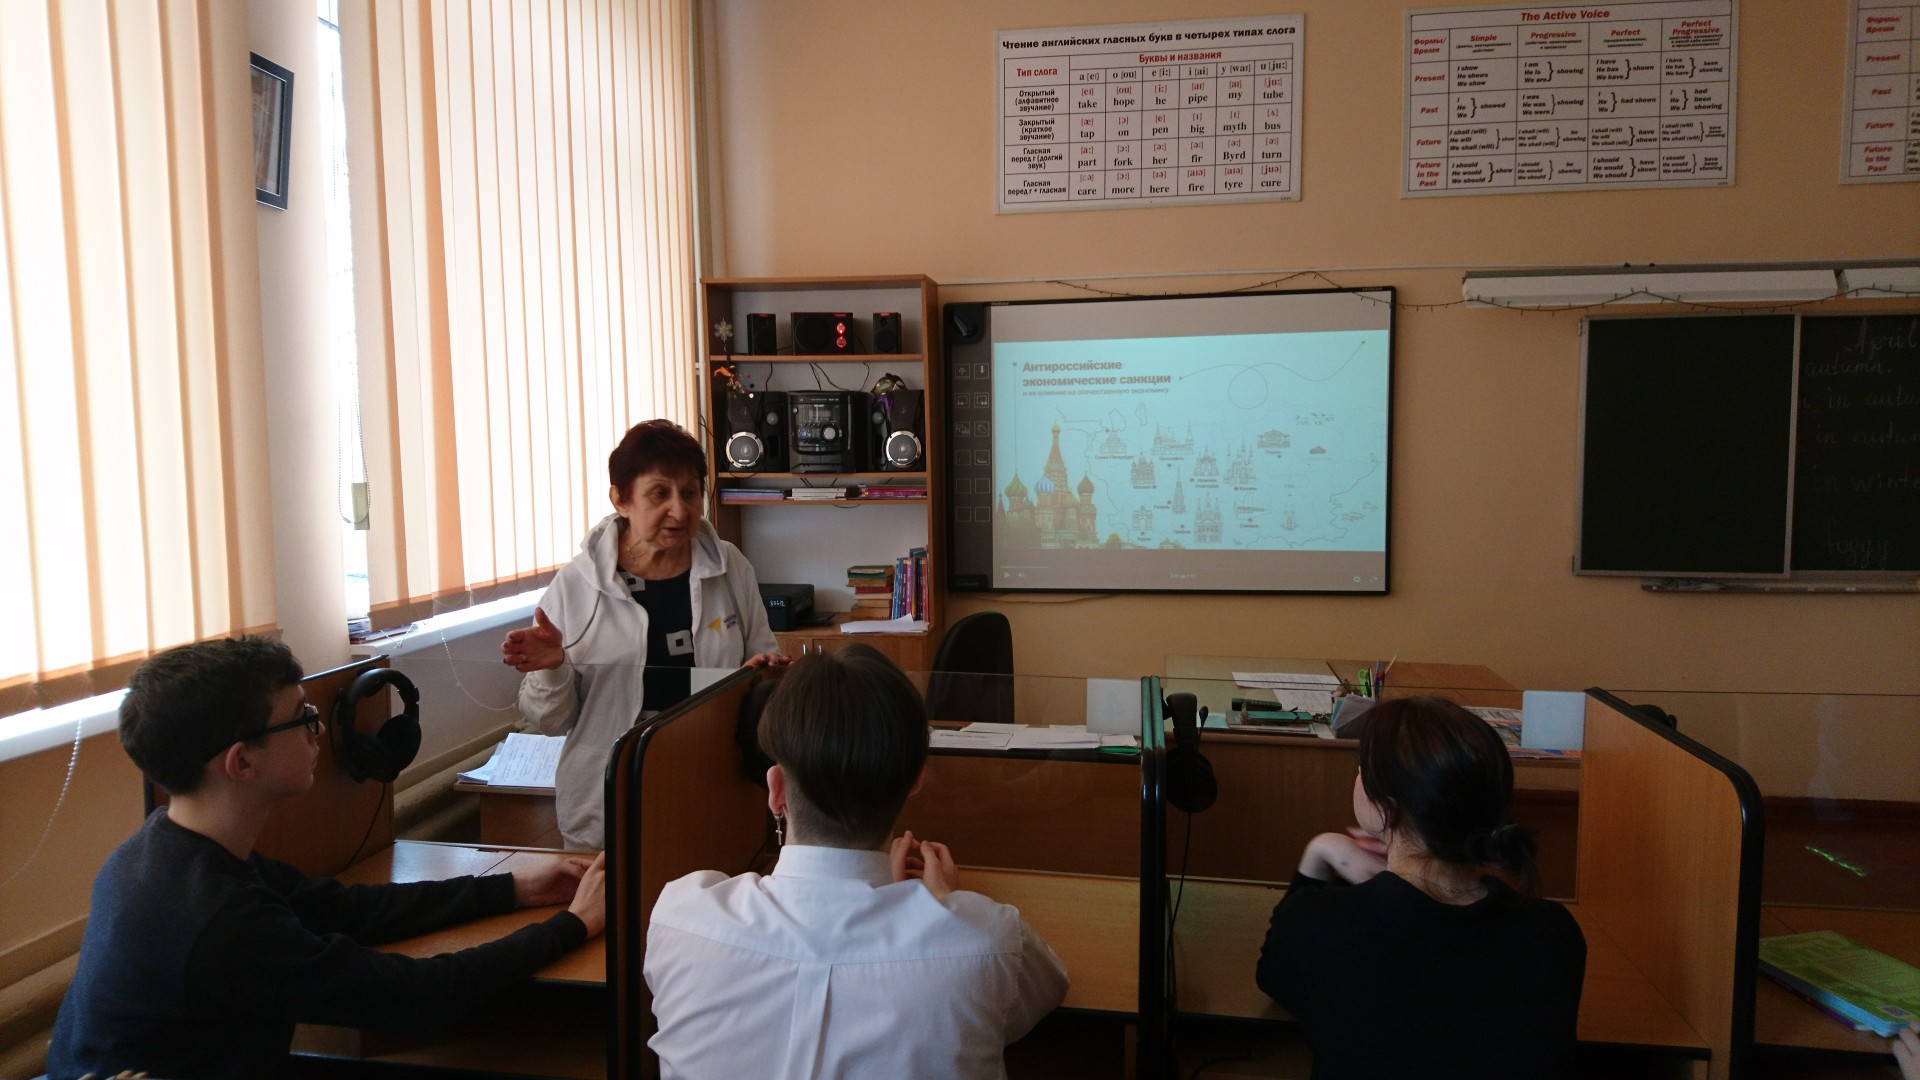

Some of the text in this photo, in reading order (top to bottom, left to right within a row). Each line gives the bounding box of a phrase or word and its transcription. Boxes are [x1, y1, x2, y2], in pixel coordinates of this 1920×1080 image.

[1521, 10, 1610, 21] The Active Voice
[1531, 31, 1576, 39] Progressive
[1673, 27, 1720, 35] Progressive
[1002, 41, 1039, 50] Чтение
[1042, 37, 1100, 47] английских
[1103, 35, 1146, 44] гласных
[1149, 32, 1172, 43] букв
[1185, 31, 1230, 40] четырех
[1233, 28, 1263, 37] типах
[1266, 26, 1296, 34] слога
[1470, 35, 1498, 43] Simple
[1139, 54, 1168, 64] Буквы
[1178, 51, 1222, 61] названия
[1866, 54, 1901, 62] Present
[1017, 68, 1058, 77] Тип слога
[1188, 68, 1192, 76] i
[1221, 66, 1226, 75] y
[1415, 74, 1445, 82] Present
[1188, 94, 1208, 104] pipe
[1228, 91, 1242, 100] my
[1263, 91, 1284, 99] tube
[1078, 100, 1098, 108] take
[1113, 98, 1135, 108] hope
[1156, 96, 1166, 105] he
[1019, 104, 1055, 112] звучание)
[1022, 126, 1052, 134] (краткое
[1190, 124, 1205, 134] big
[1223, 122, 1247, 132] myth
[1264, 122, 1281, 130] bus
[1080, 130, 1094, 138] tap
[1152, 125, 1168, 136] pen
[1019, 133, 1055, 141] звучание)
[1037, 154, 1062, 162] (долгий
[1191, 154, 1202, 163] fir
[1223, 151, 1246, 162] Byrd
[1262, 151, 1282, 159] turn
[1875, 155, 1890, 163] the
[1078, 158, 1096, 168] part
[1114, 158, 1133, 166] fork
[1152, 156, 1168, 164] her
[1224, 181, 1243, 190] tyre
[1261, 179, 1282, 187] cure
[1112, 186, 1135, 194] more
[1149, 185, 1170, 193] here
[1188, 183, 1204, 192] fire
[1023, 360, 1122, 373] Антироссийские
[1022, 375, 1171, 387] экономические санкции
